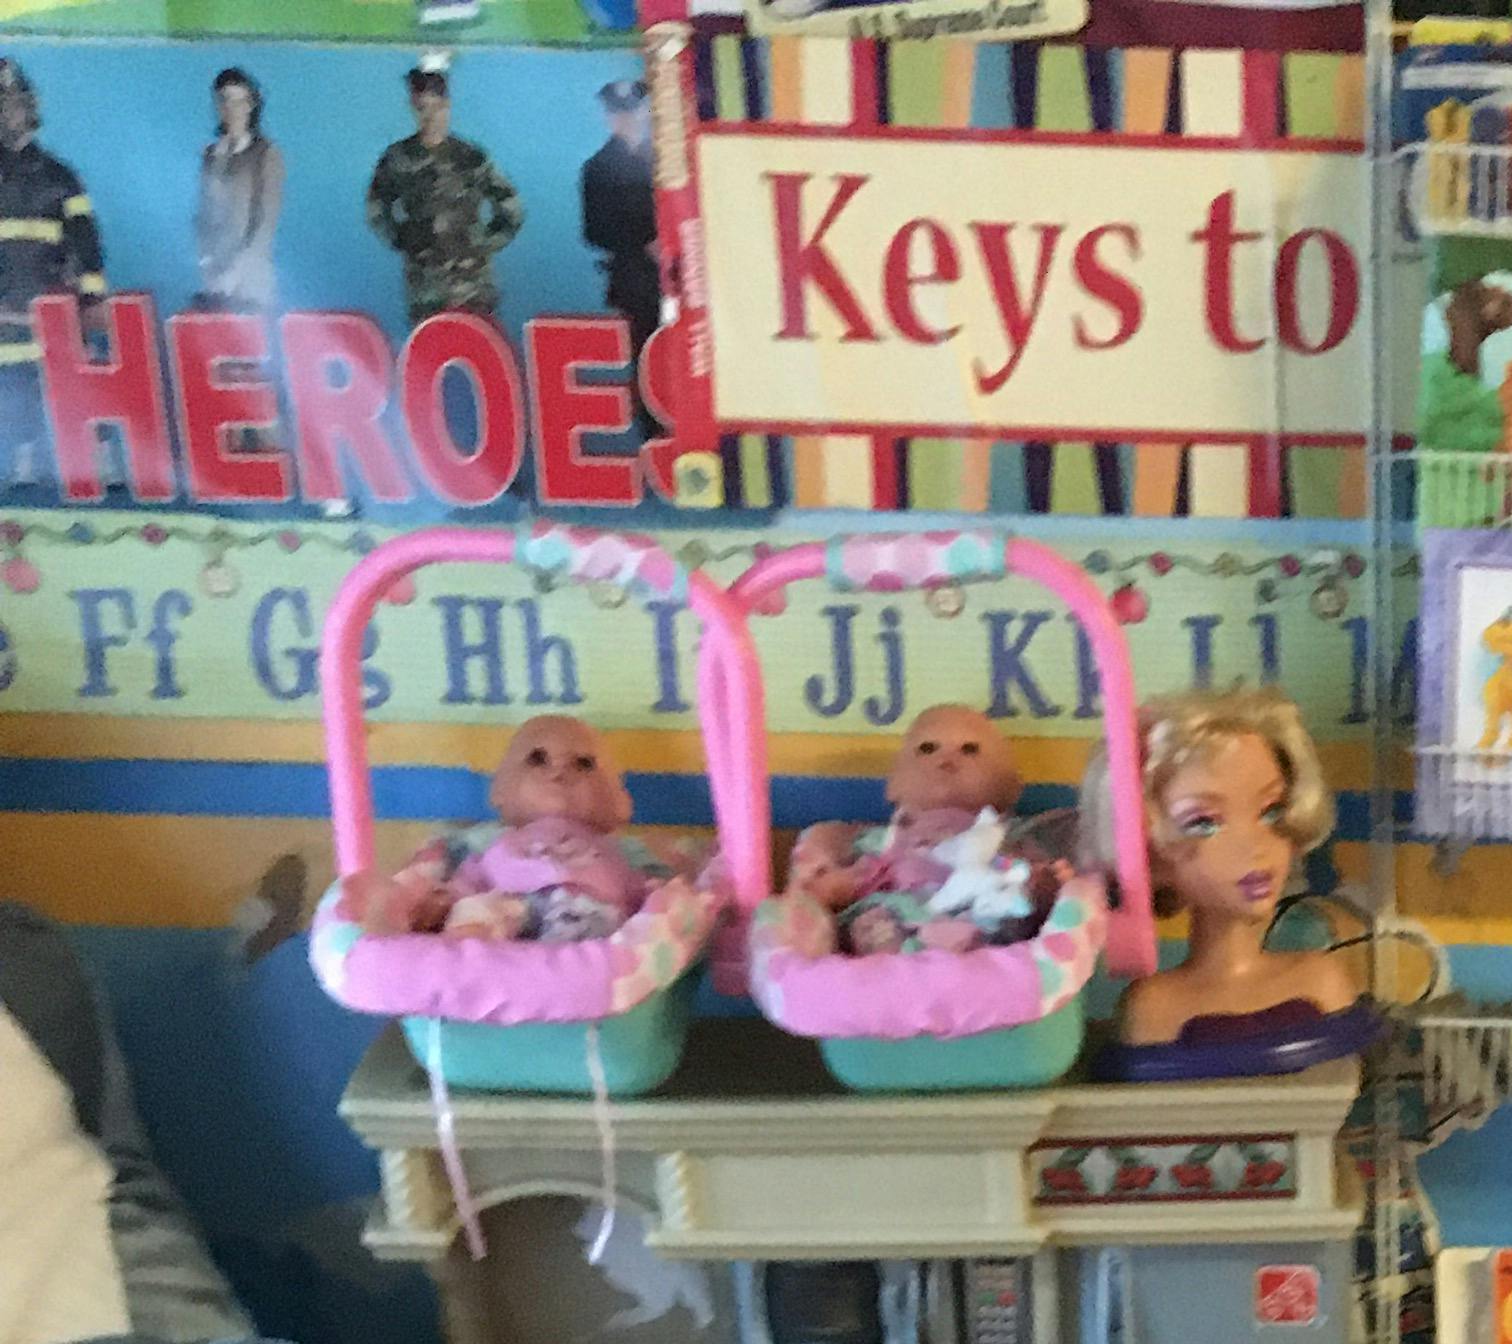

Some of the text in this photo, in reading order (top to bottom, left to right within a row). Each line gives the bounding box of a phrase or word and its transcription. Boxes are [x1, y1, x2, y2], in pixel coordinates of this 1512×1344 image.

[764, 170, 1360, 395] Keys to
[69, 587, 191, 700] Ff
[431, 594, 584, 706] Hh
[645, 602, 697, 714] I
[803, 604, 908, 725] Jj
